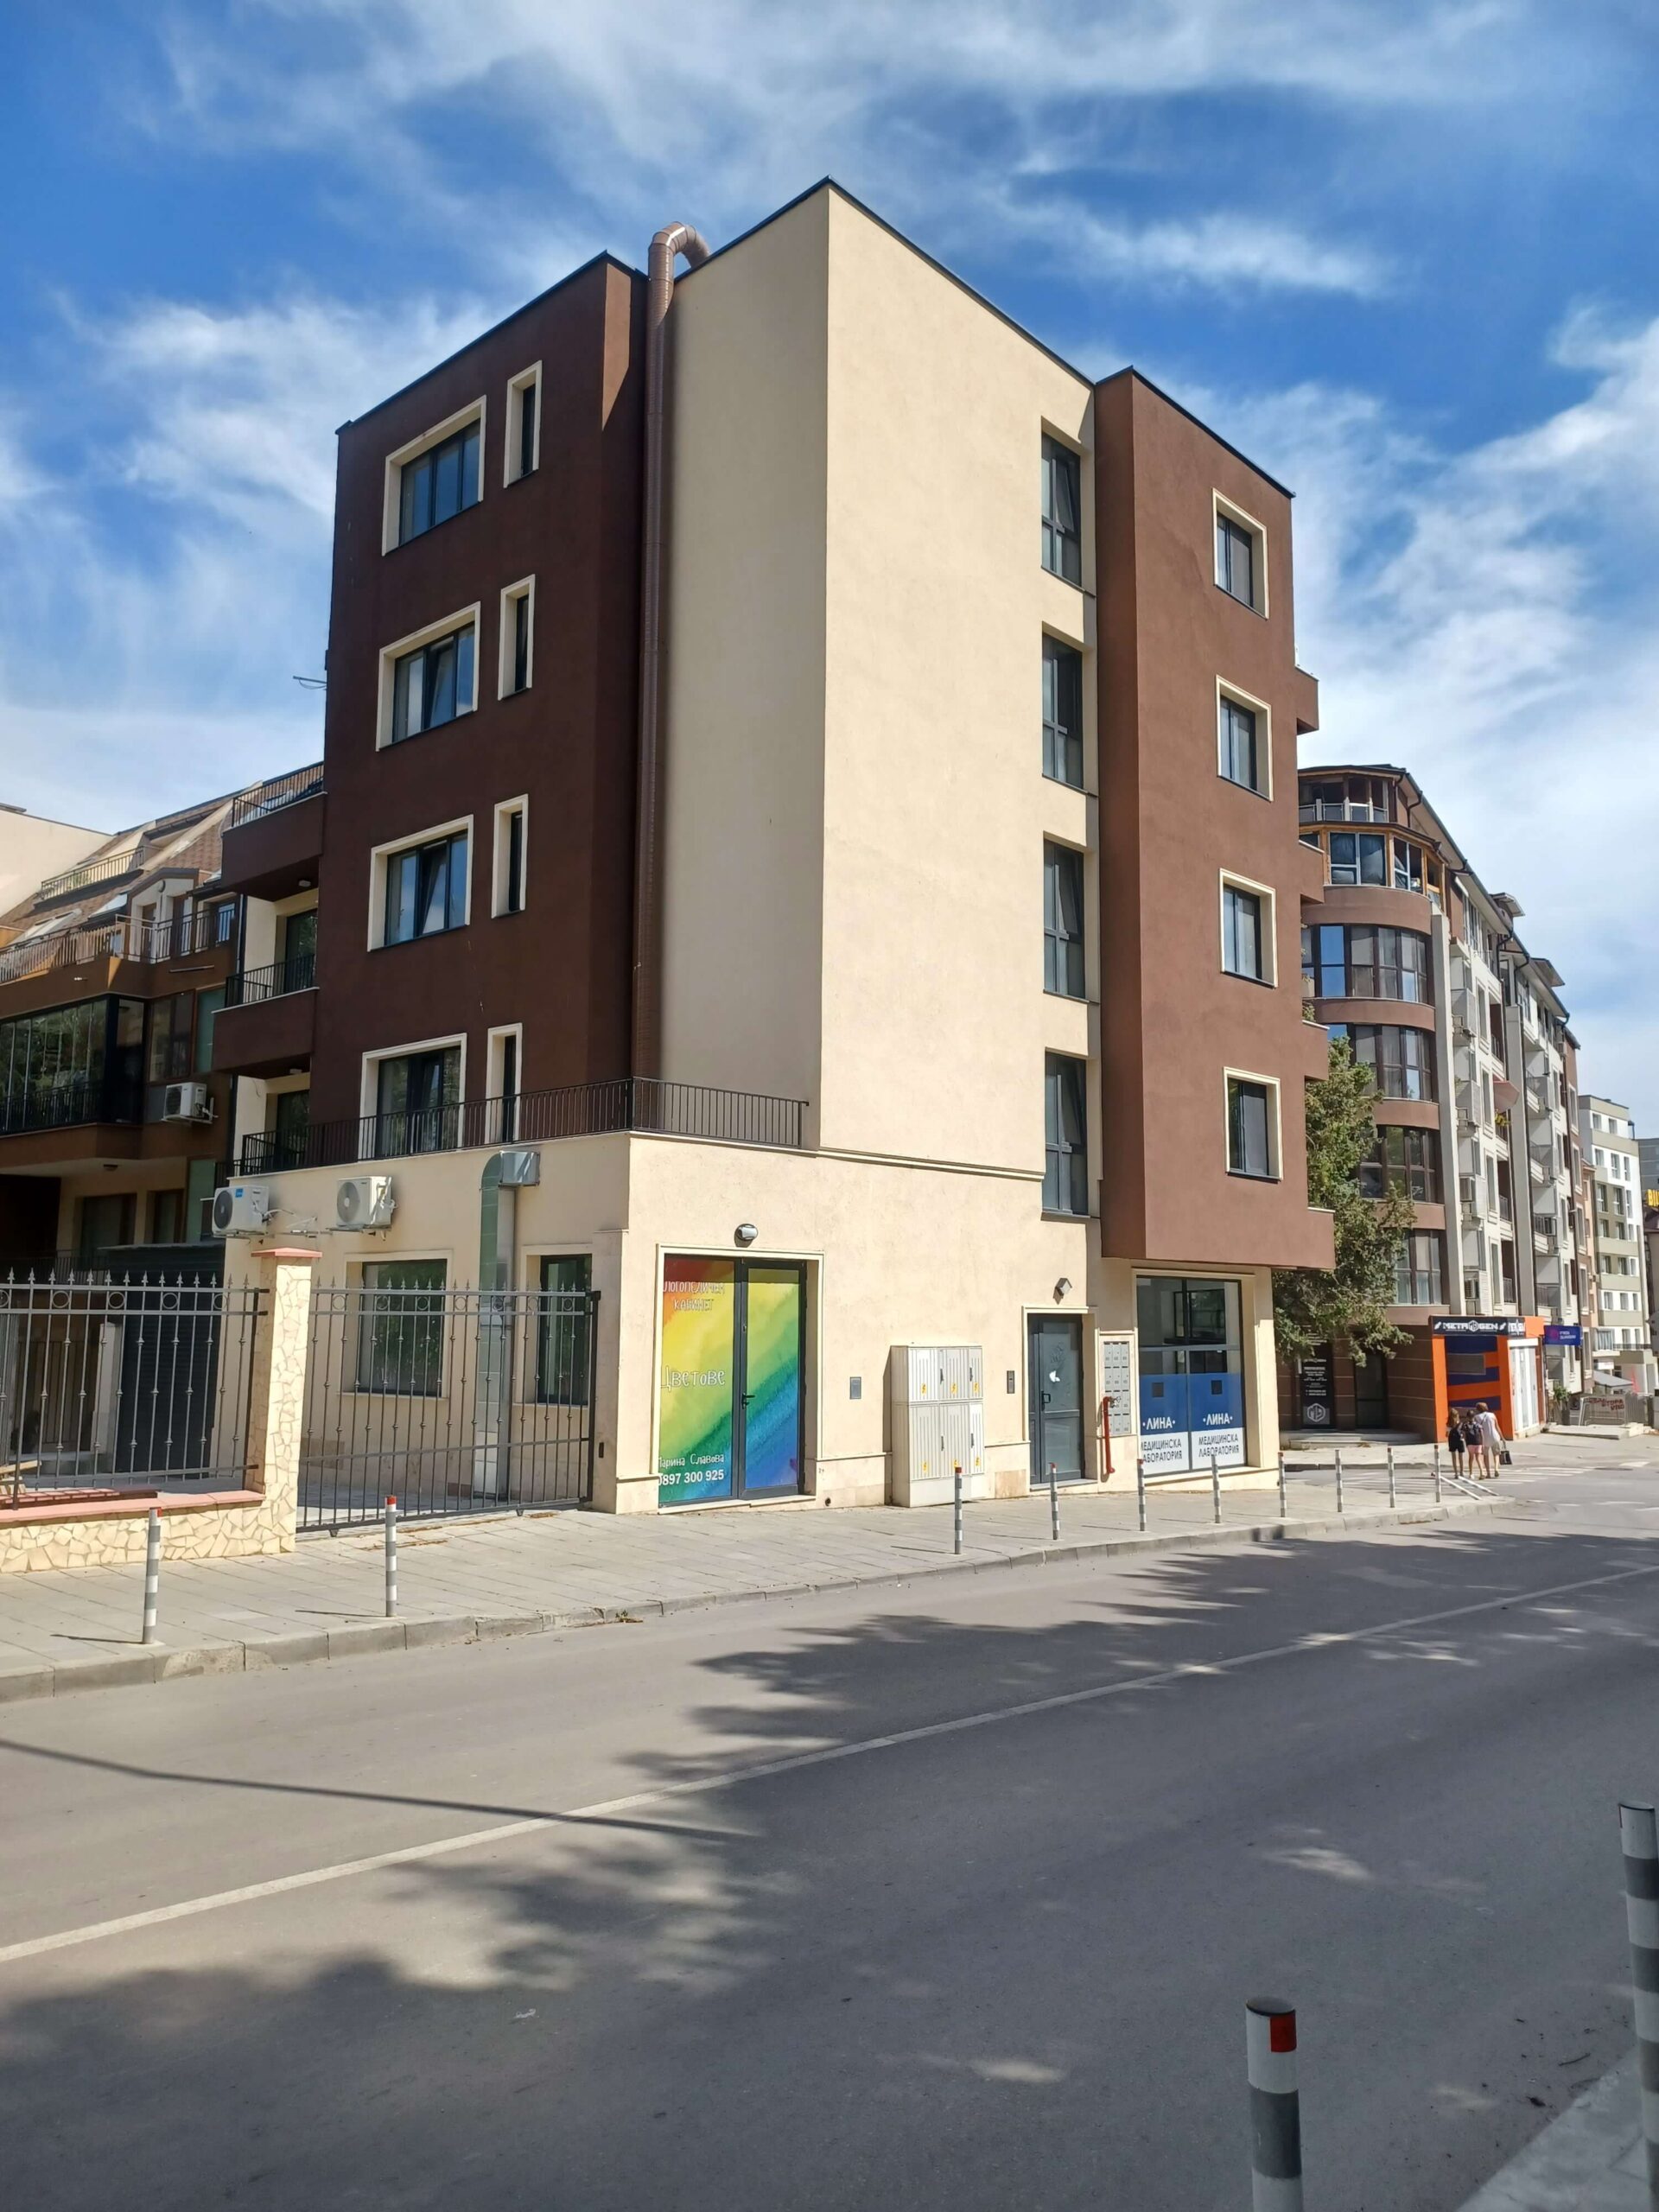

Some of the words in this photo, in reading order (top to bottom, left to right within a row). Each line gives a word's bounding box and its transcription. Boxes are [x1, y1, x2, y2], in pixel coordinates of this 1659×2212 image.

[1198, 1433, 1238, 1445] МЕДИЦИНСКА
[1142, 1450, 1183, 1463] АБОРАТОРИЯ
[1198, 1445, 1239, 1457] ЛАБОРАТОРИЯ
[690, 1453, 725, 1465] Славова
[683, 1471, 703, 1483] 300
[705, 1469, 725, 1481] 925
